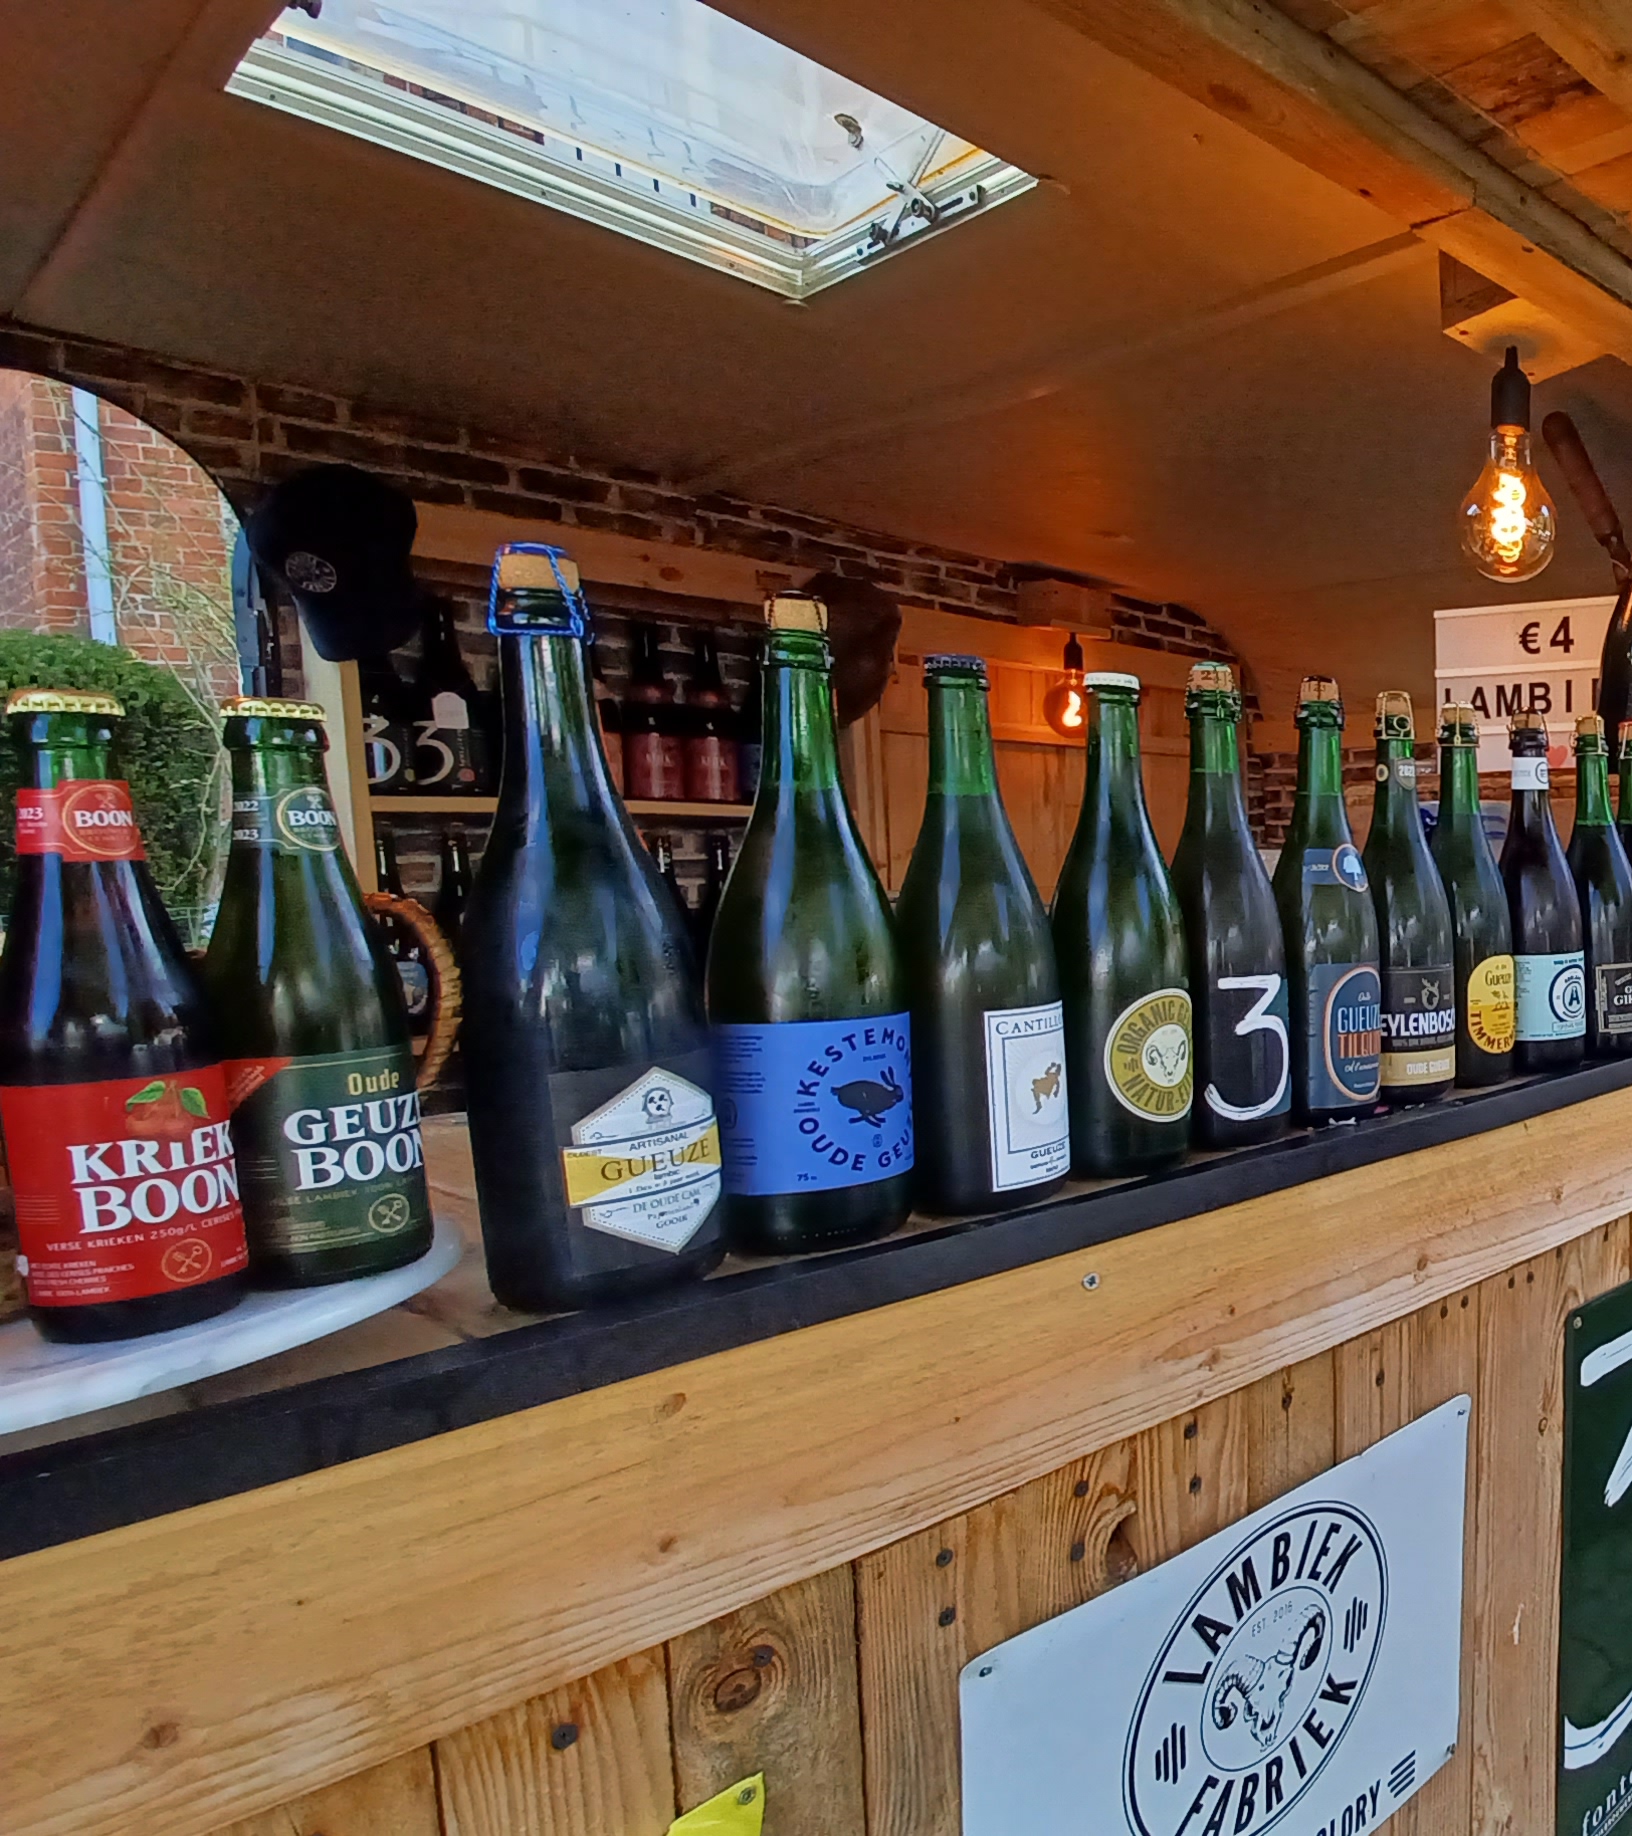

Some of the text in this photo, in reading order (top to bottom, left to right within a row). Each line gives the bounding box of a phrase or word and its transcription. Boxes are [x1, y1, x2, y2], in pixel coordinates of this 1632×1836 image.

[74, 809, 133, 828] BOON
[288, 810, 336, 827] BOON
[1117, 1000, 1175, 1055] ORGANIC
[1204, 973, 1289, 1120] 3
[348, 1069, 400, 1095] Oude
[1407, 1061, 1428, 1075] OUDE
[66, 1120, 235, 1184] KRIEK
[601, 1138, 710, 1181] GUEUZE
[629, 1132, 689, 1151] ARTISANAL
[799, 1117, 866, 1171] OUDE
[73, 1158, 240, 1234] BOON
[47, 1241, 82, 1252] VERSE
[87, 1233, 144, 1249] KRIEKEN
[1163, 1520, 1362, 1685] LAMBIEK
[1174, 1673, 1358, 1836] FABRIEK
